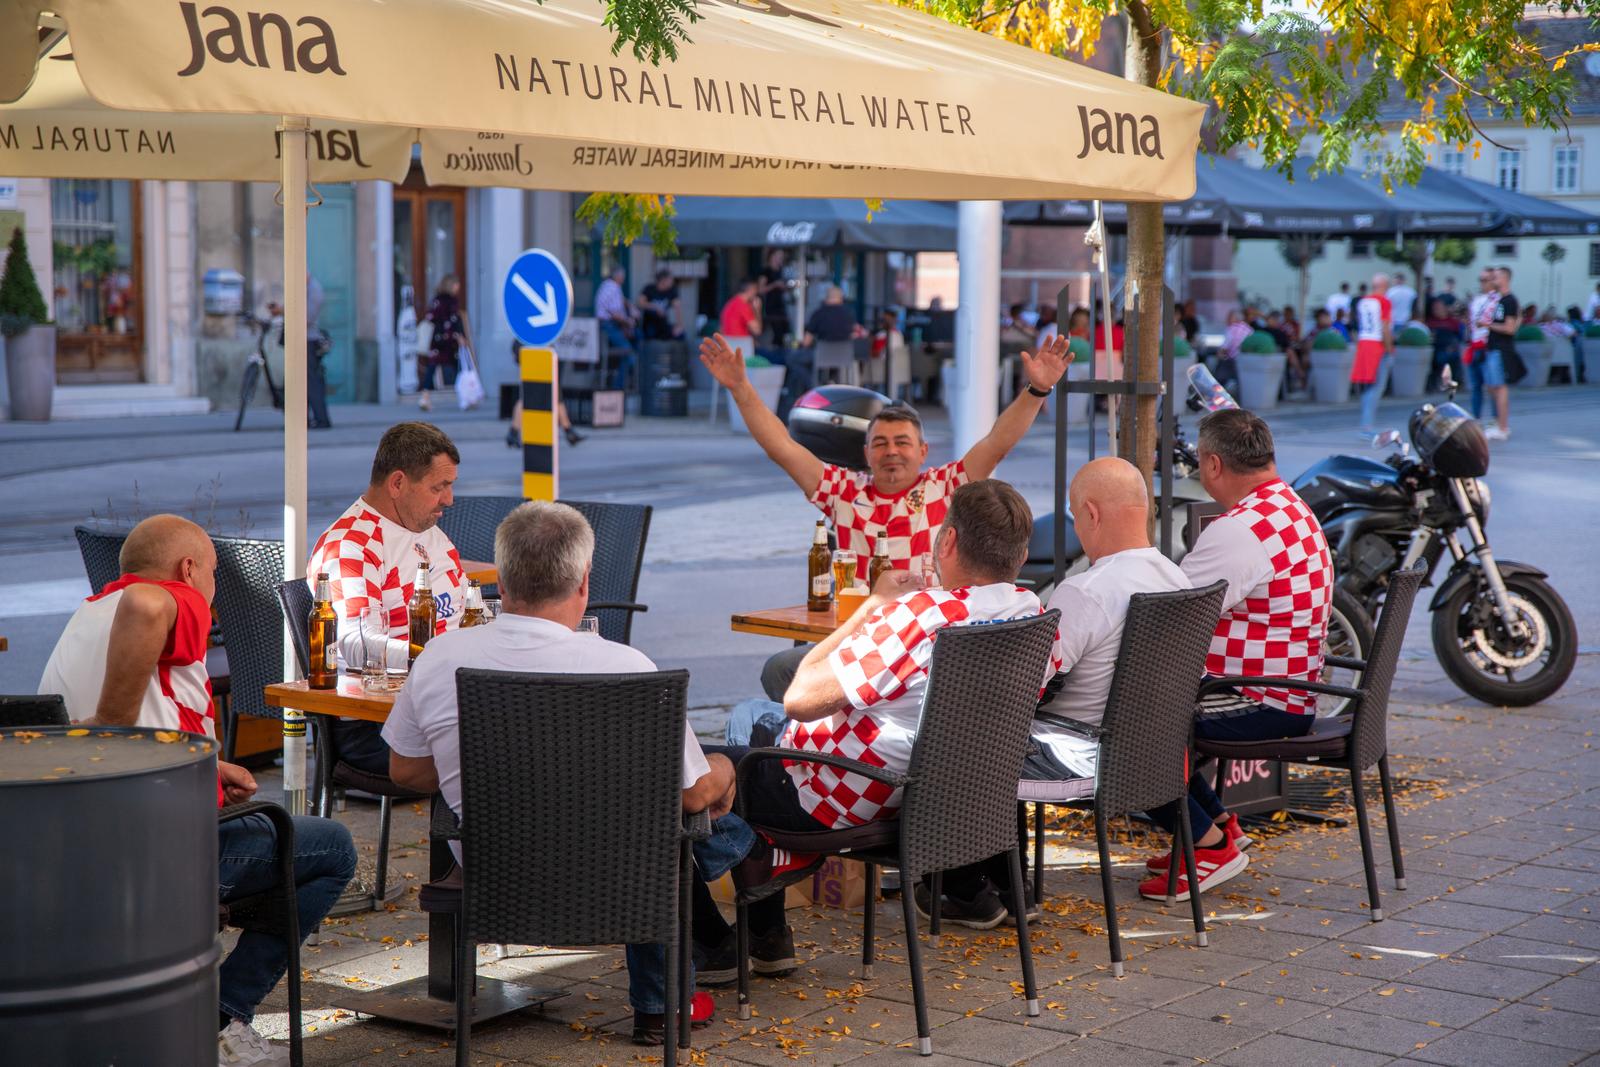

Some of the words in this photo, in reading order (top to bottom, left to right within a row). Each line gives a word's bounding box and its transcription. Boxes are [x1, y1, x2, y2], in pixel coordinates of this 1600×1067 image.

[177, 1, 347, 77] Jana
[494, 52, 683, 109] NATURAL
[693, 77, 855, 126] MINERAL
[861, 94, 976, 136] WATER
[1077, 105, 1165, 160] Jana
